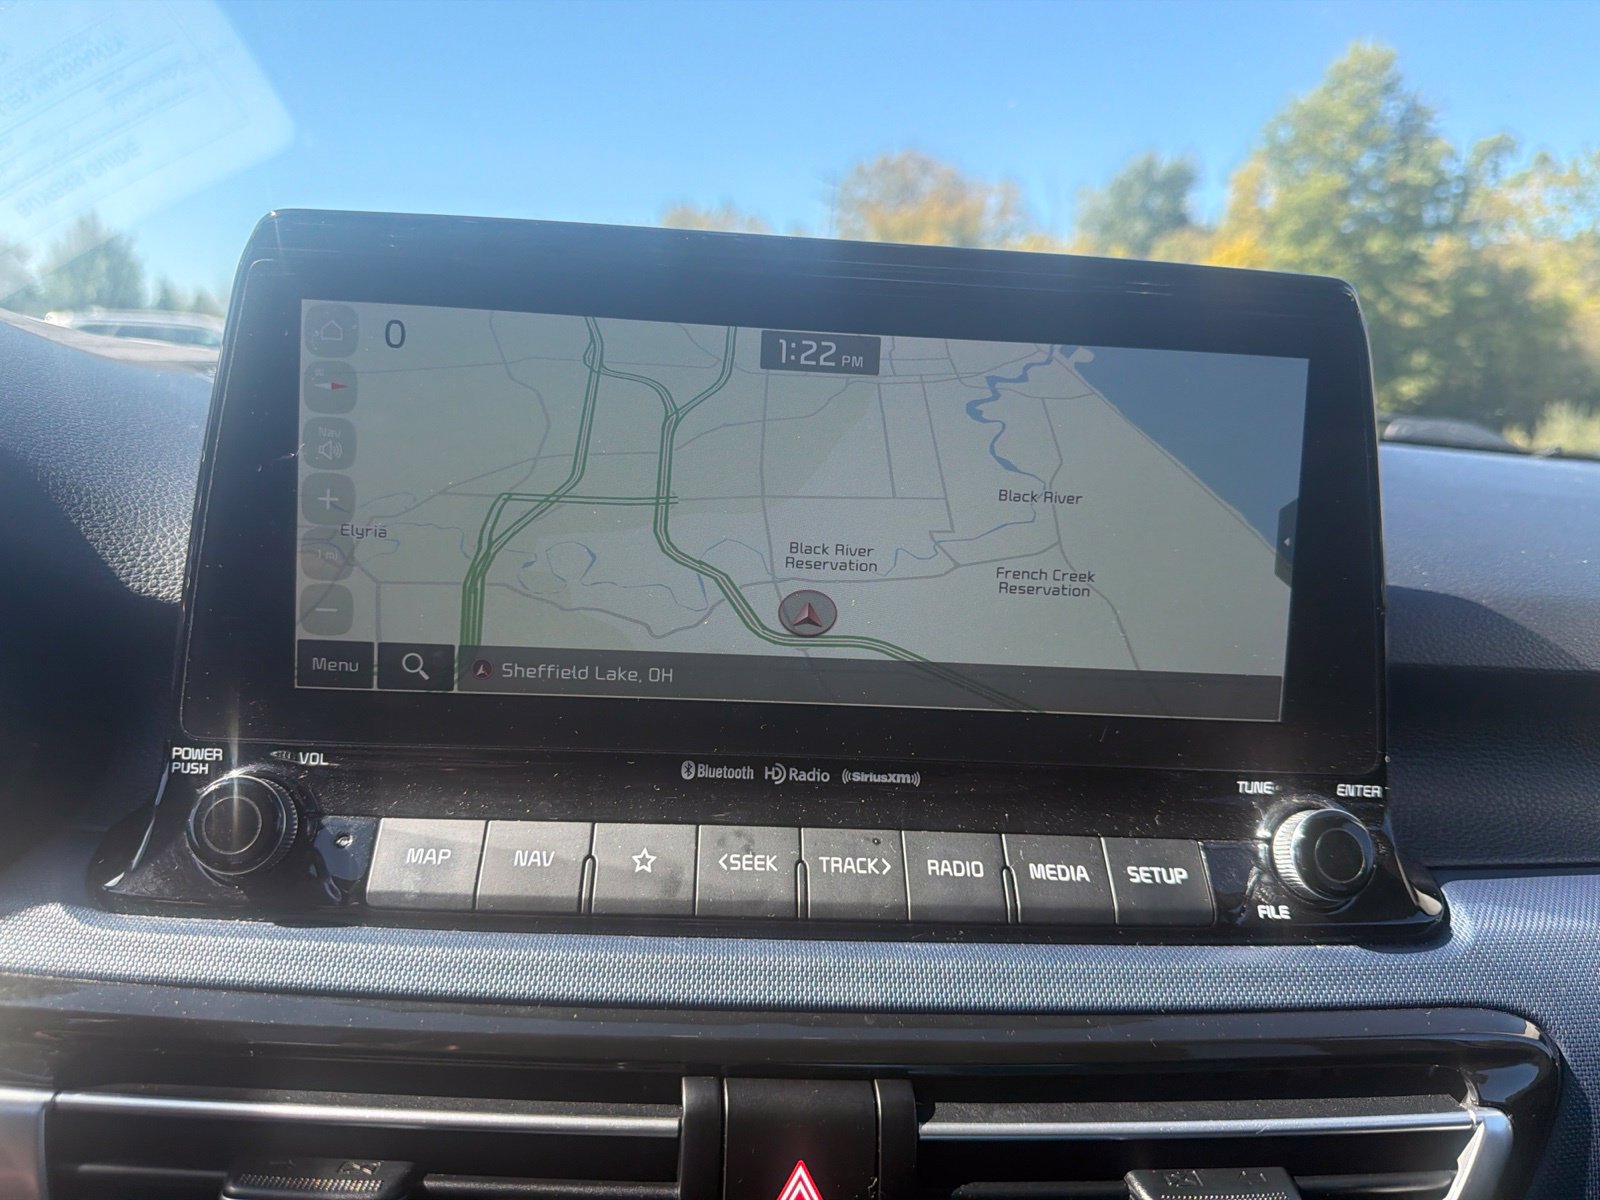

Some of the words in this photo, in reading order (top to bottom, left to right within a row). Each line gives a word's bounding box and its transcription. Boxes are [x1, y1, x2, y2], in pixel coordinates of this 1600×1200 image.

[777, 338, 837, 367] 1:22
[842, 355, 864, 369] PM
[998, 489, 1038, 504] Black
[1043, 491, 1083, 506] River
[340, 523, 388, 539] Elyria
[789, 541, 832, 557] Black
[836, 544, 874, 558] River
[785, 556, 878, 574] Reservation
[996, 567, 1048, 582] French
[1053, 570, 1096, 585] Creek
[998, 582, 1091, 598] Reservation
[312, 656, 359, 673] Menu
[501, 662, 589, 681] Sheffield
[594, 665, 642, 683] Lake,
[649, 667, 674, 683] OH
[171, 747, 223, 761] POWER
[299, 752, 328, 766] VOL
[171, 762, 209, 775] PUSH
[697, 763, 754, 780] Bluetooth
[789, 767, 831, 783] Radio
[1236, 781, 1275, 795] TUNE
[1336, 783, 1383, 798] ENTER
[406, 848, 452, 865] MAP
[513, 850, 555, 868] NAV
[926, 859, 985, 878] RADIO
[1029, 862, 1090, 883] MEDIA
[1127, 865, 1189, 885] SETUP
[1257, 904, 1292, 920] FILE
